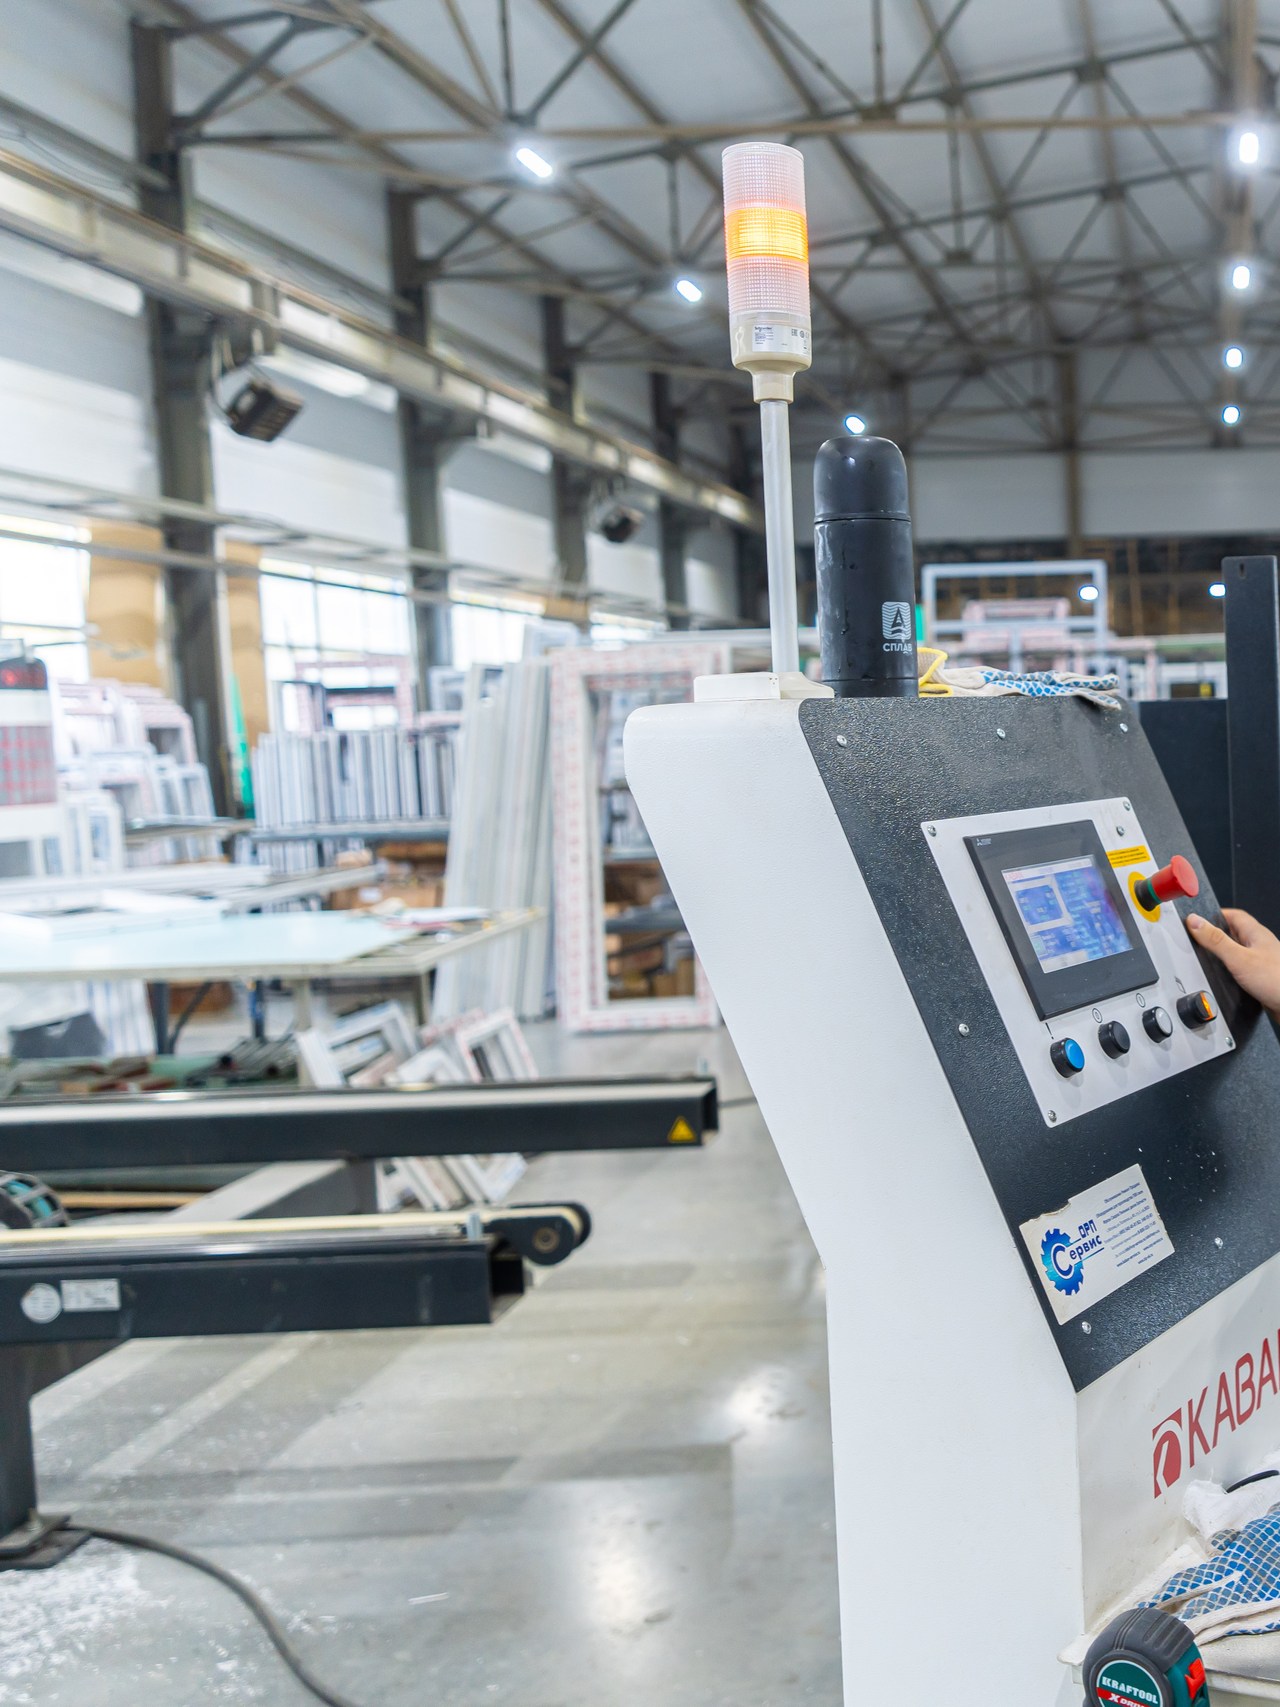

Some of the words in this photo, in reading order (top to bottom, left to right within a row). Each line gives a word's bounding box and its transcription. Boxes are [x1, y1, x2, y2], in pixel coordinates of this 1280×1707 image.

[883, 642, 912, 652] СПЛАВ
[1053, 1235, 1102, 1276] Сервис
[1102, 1676, 1158, 1705] KRAFTOOL
